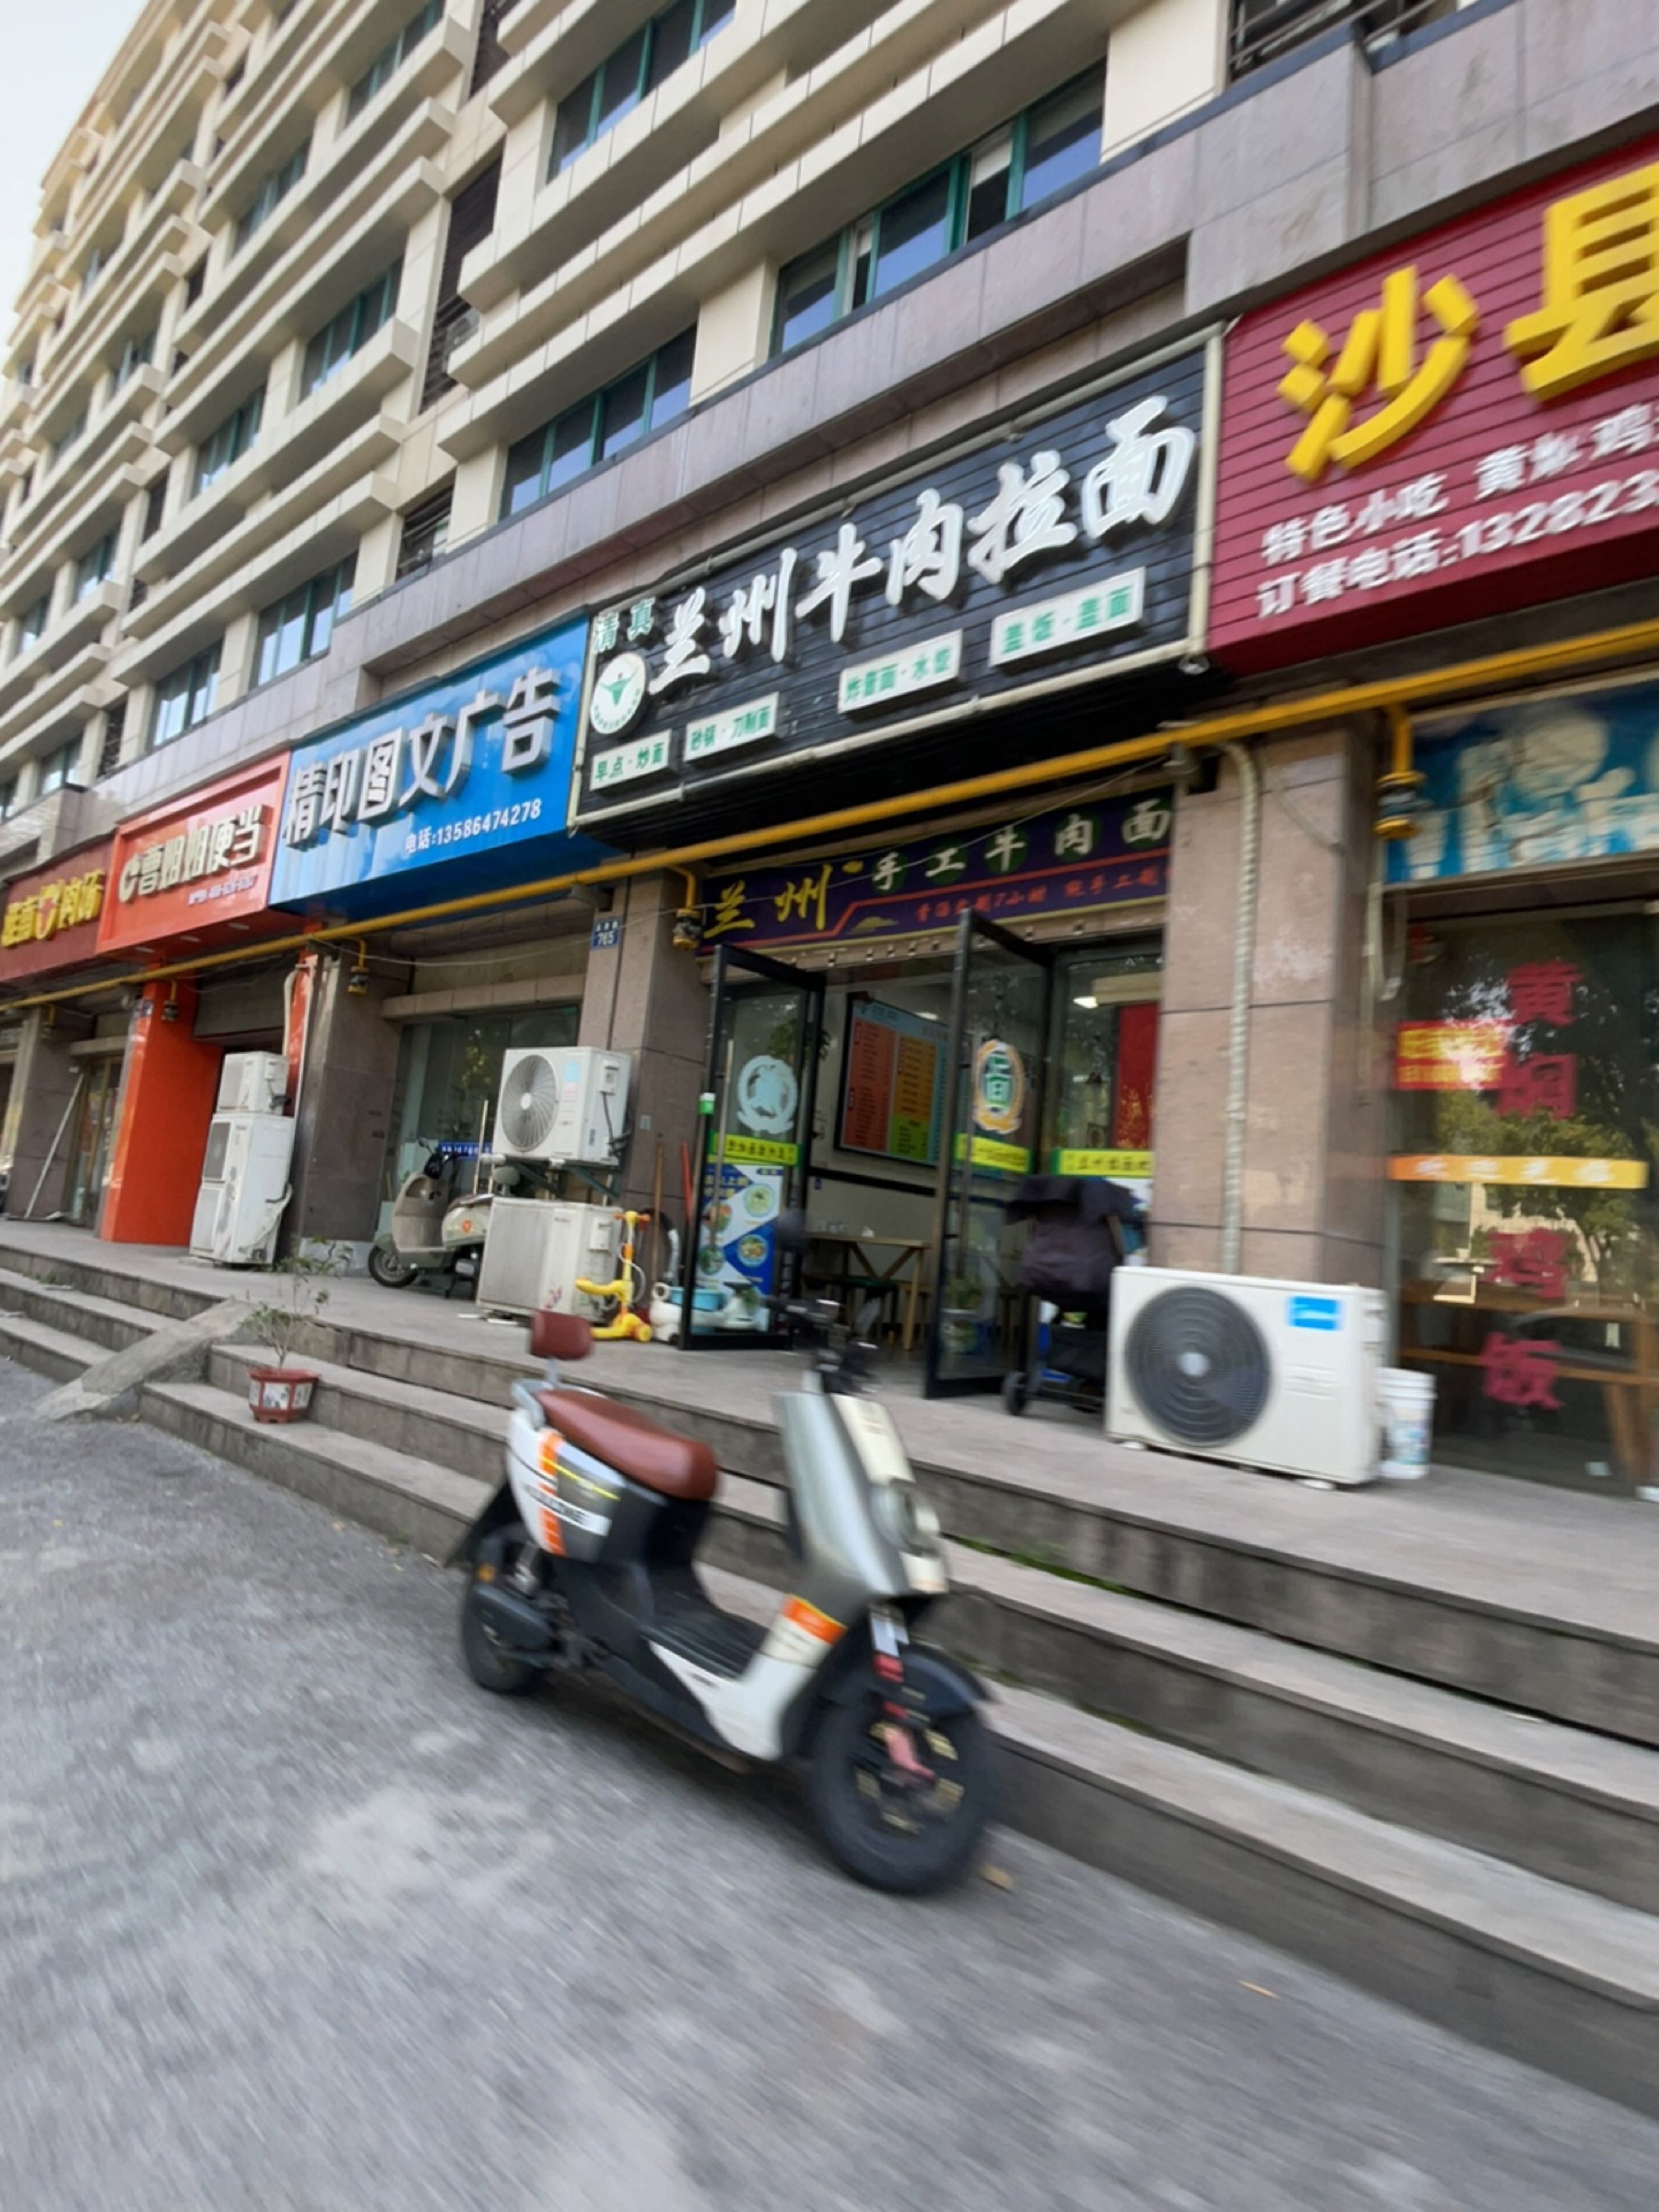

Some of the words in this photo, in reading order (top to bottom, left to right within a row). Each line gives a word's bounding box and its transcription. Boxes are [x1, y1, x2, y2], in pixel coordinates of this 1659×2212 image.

[1276, 160, 1659, 484] 沙县
[647, 394, 1196, 695] 兰州牛肉拉面
[1256, 468, 1659, 618] 订餐电话:132823
[1260, 472, 1448, 566] 特色小吃
[1473, 402, 1659, 501] 黄焖鸡
[594, 597, 657, 654] 清真
[284, 666, 562, 848] 精印图文广告
[703, 864, 832, 938] 兰州
[870, 797, 1173, 890] 手工牛肉面
